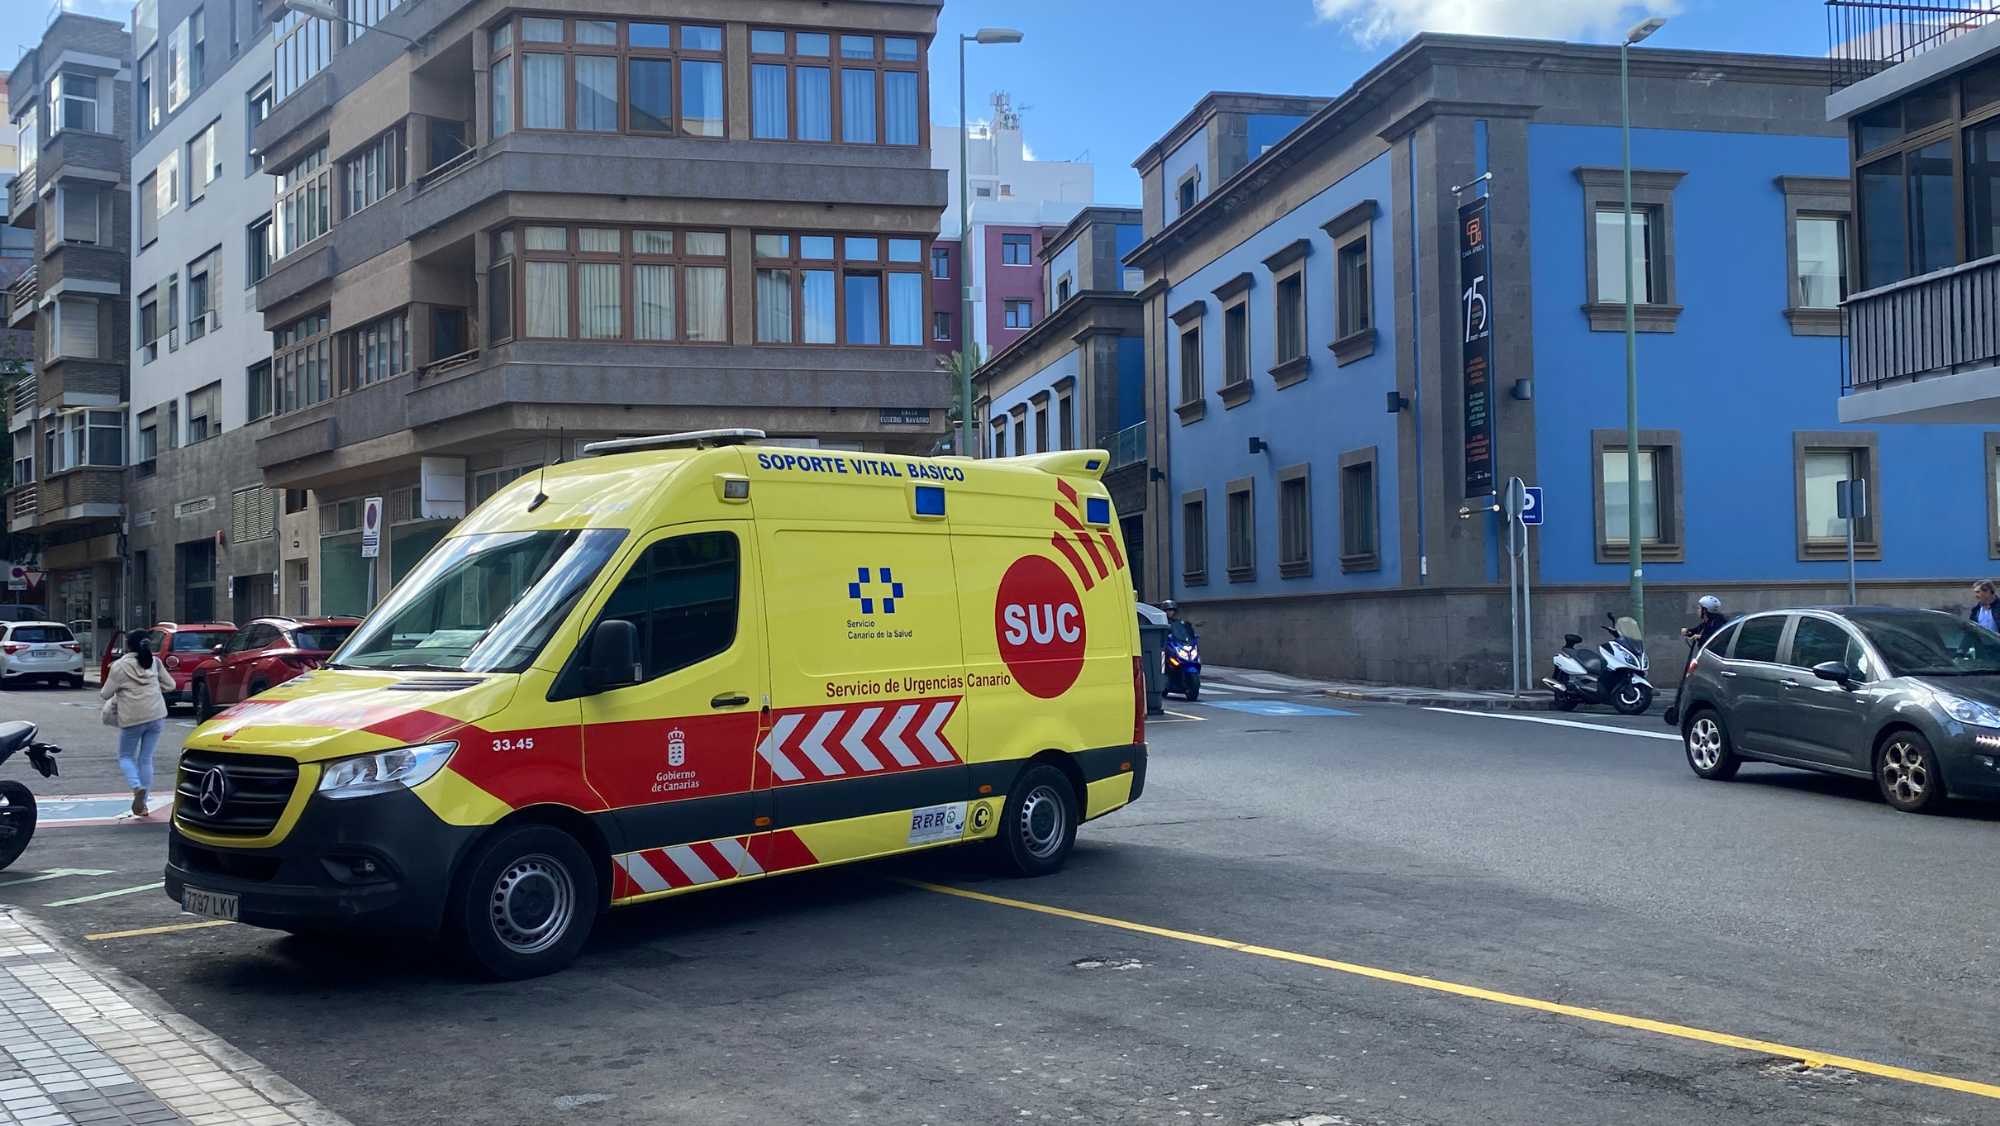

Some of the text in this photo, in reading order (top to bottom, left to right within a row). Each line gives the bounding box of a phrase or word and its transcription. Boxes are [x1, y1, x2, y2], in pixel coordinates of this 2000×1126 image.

[1463, 275, 1486, 342] 15
[906, 416, 930, 424] NAVARRO
[757, 453, 964, 482] SOPORTE VITAL BÁSICO
[846, 620, 875, 628] Servicio
[1004, 602, 1080, 645] SUC
[848, 629, 913, 640] Canario de la Salud
[826, 672, 1011, 698] Servicio de Urgencias Canario
[492, 737, 534, 751] 33.45
[656, 771, 696, 781] Gobierno
[651, 780, 700, 792] de Canarias
[187, 891, 237, 918] 7797 LKV
